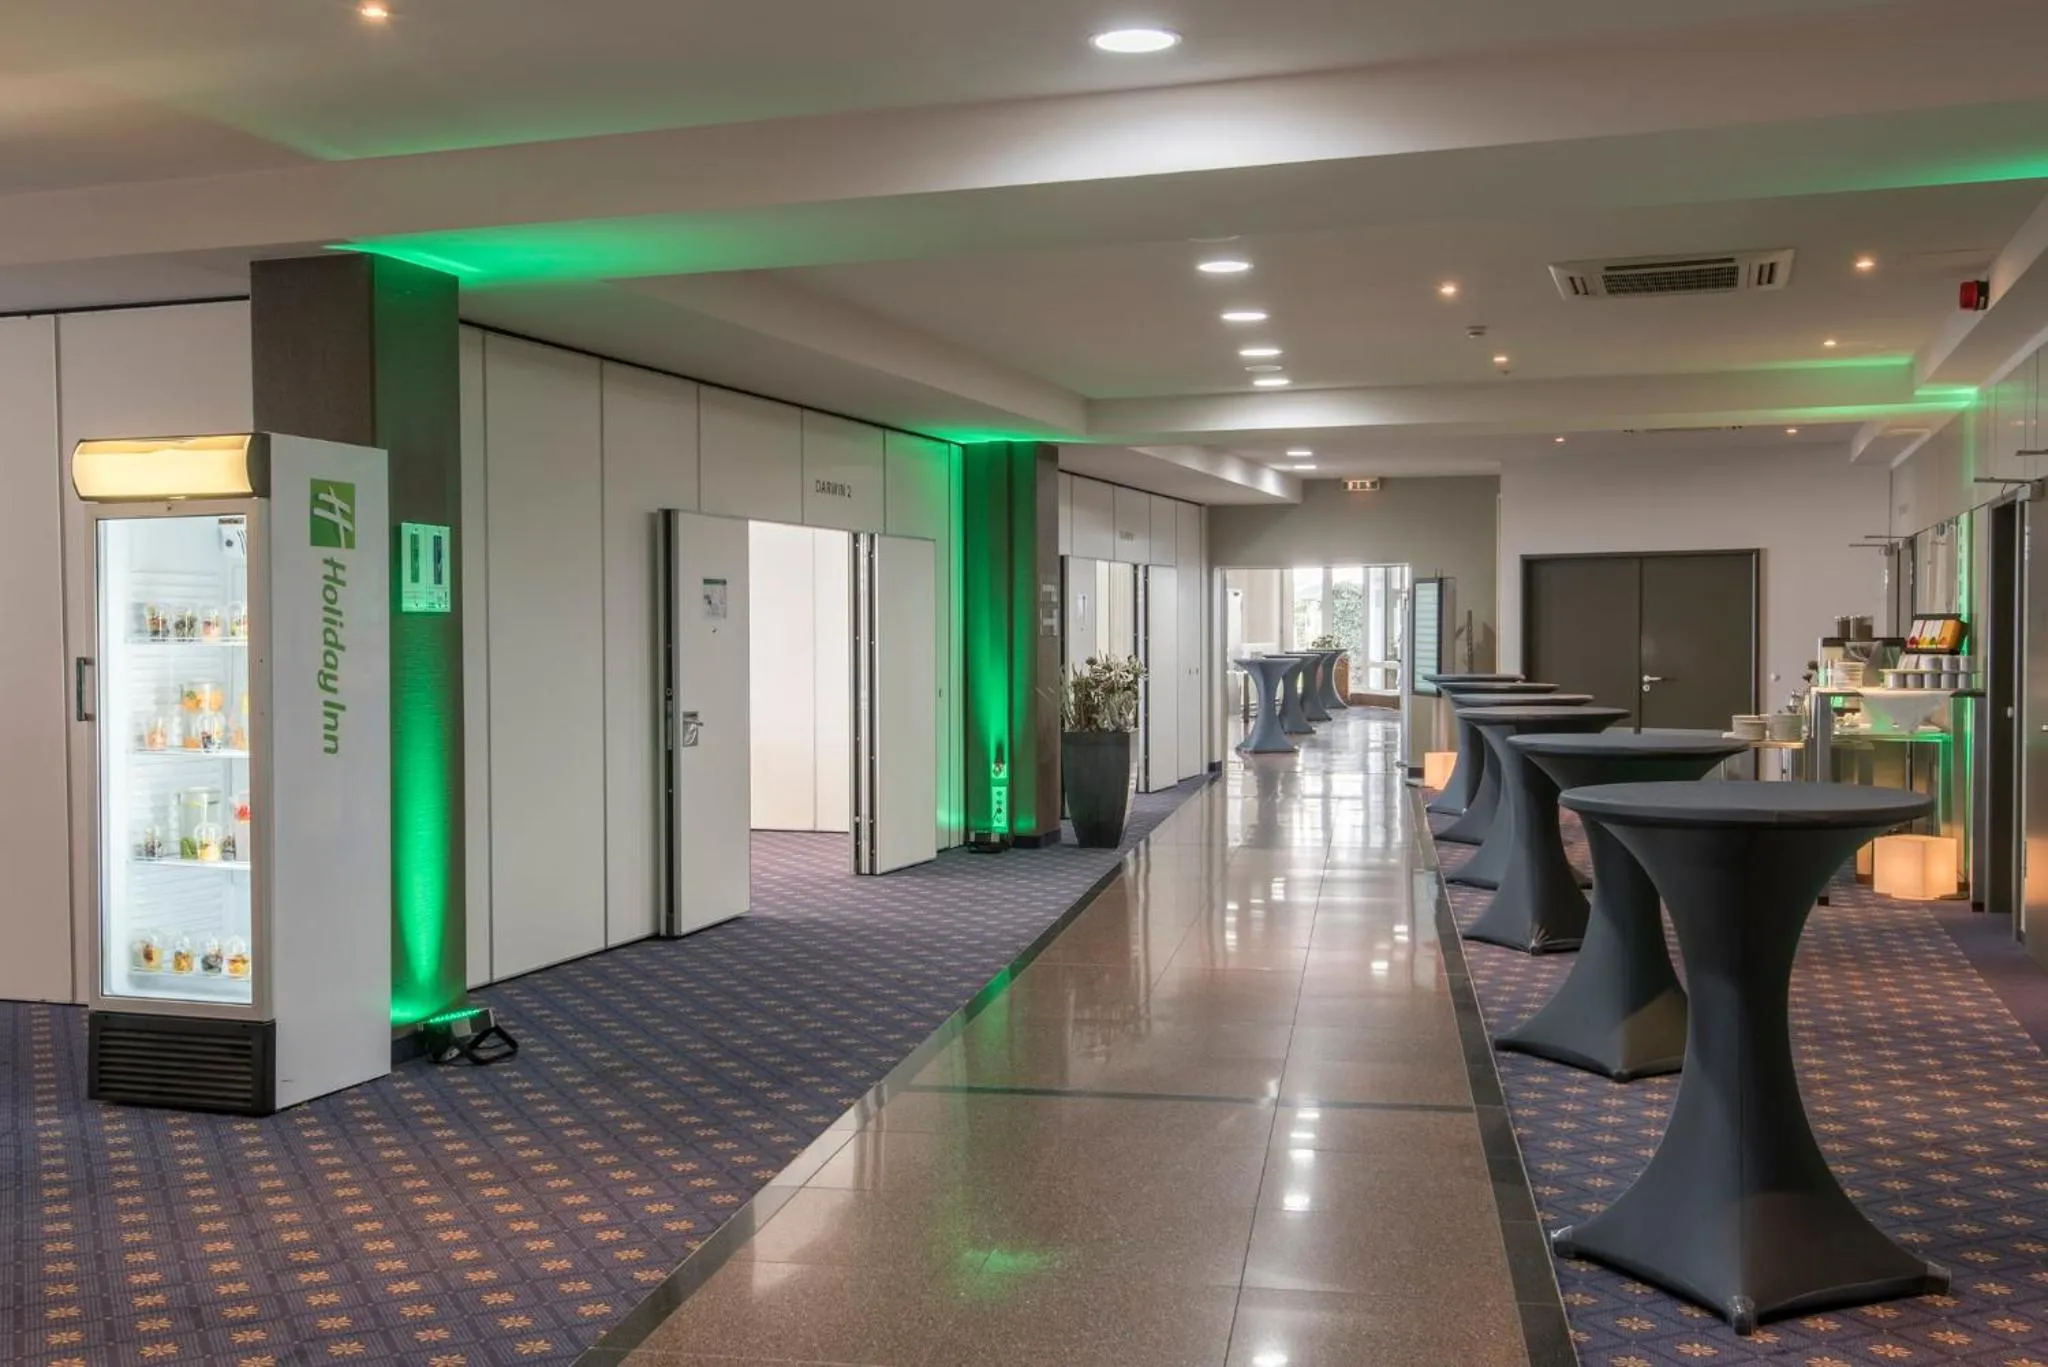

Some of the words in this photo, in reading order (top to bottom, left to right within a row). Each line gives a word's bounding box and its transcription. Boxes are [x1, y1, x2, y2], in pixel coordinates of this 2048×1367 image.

[815, 479, 846, 497] DARWIN
[847, 484, 852, 498] 2
[317, 557, 346, 695] Holiday
[322, 699, 347, 755] Inn
